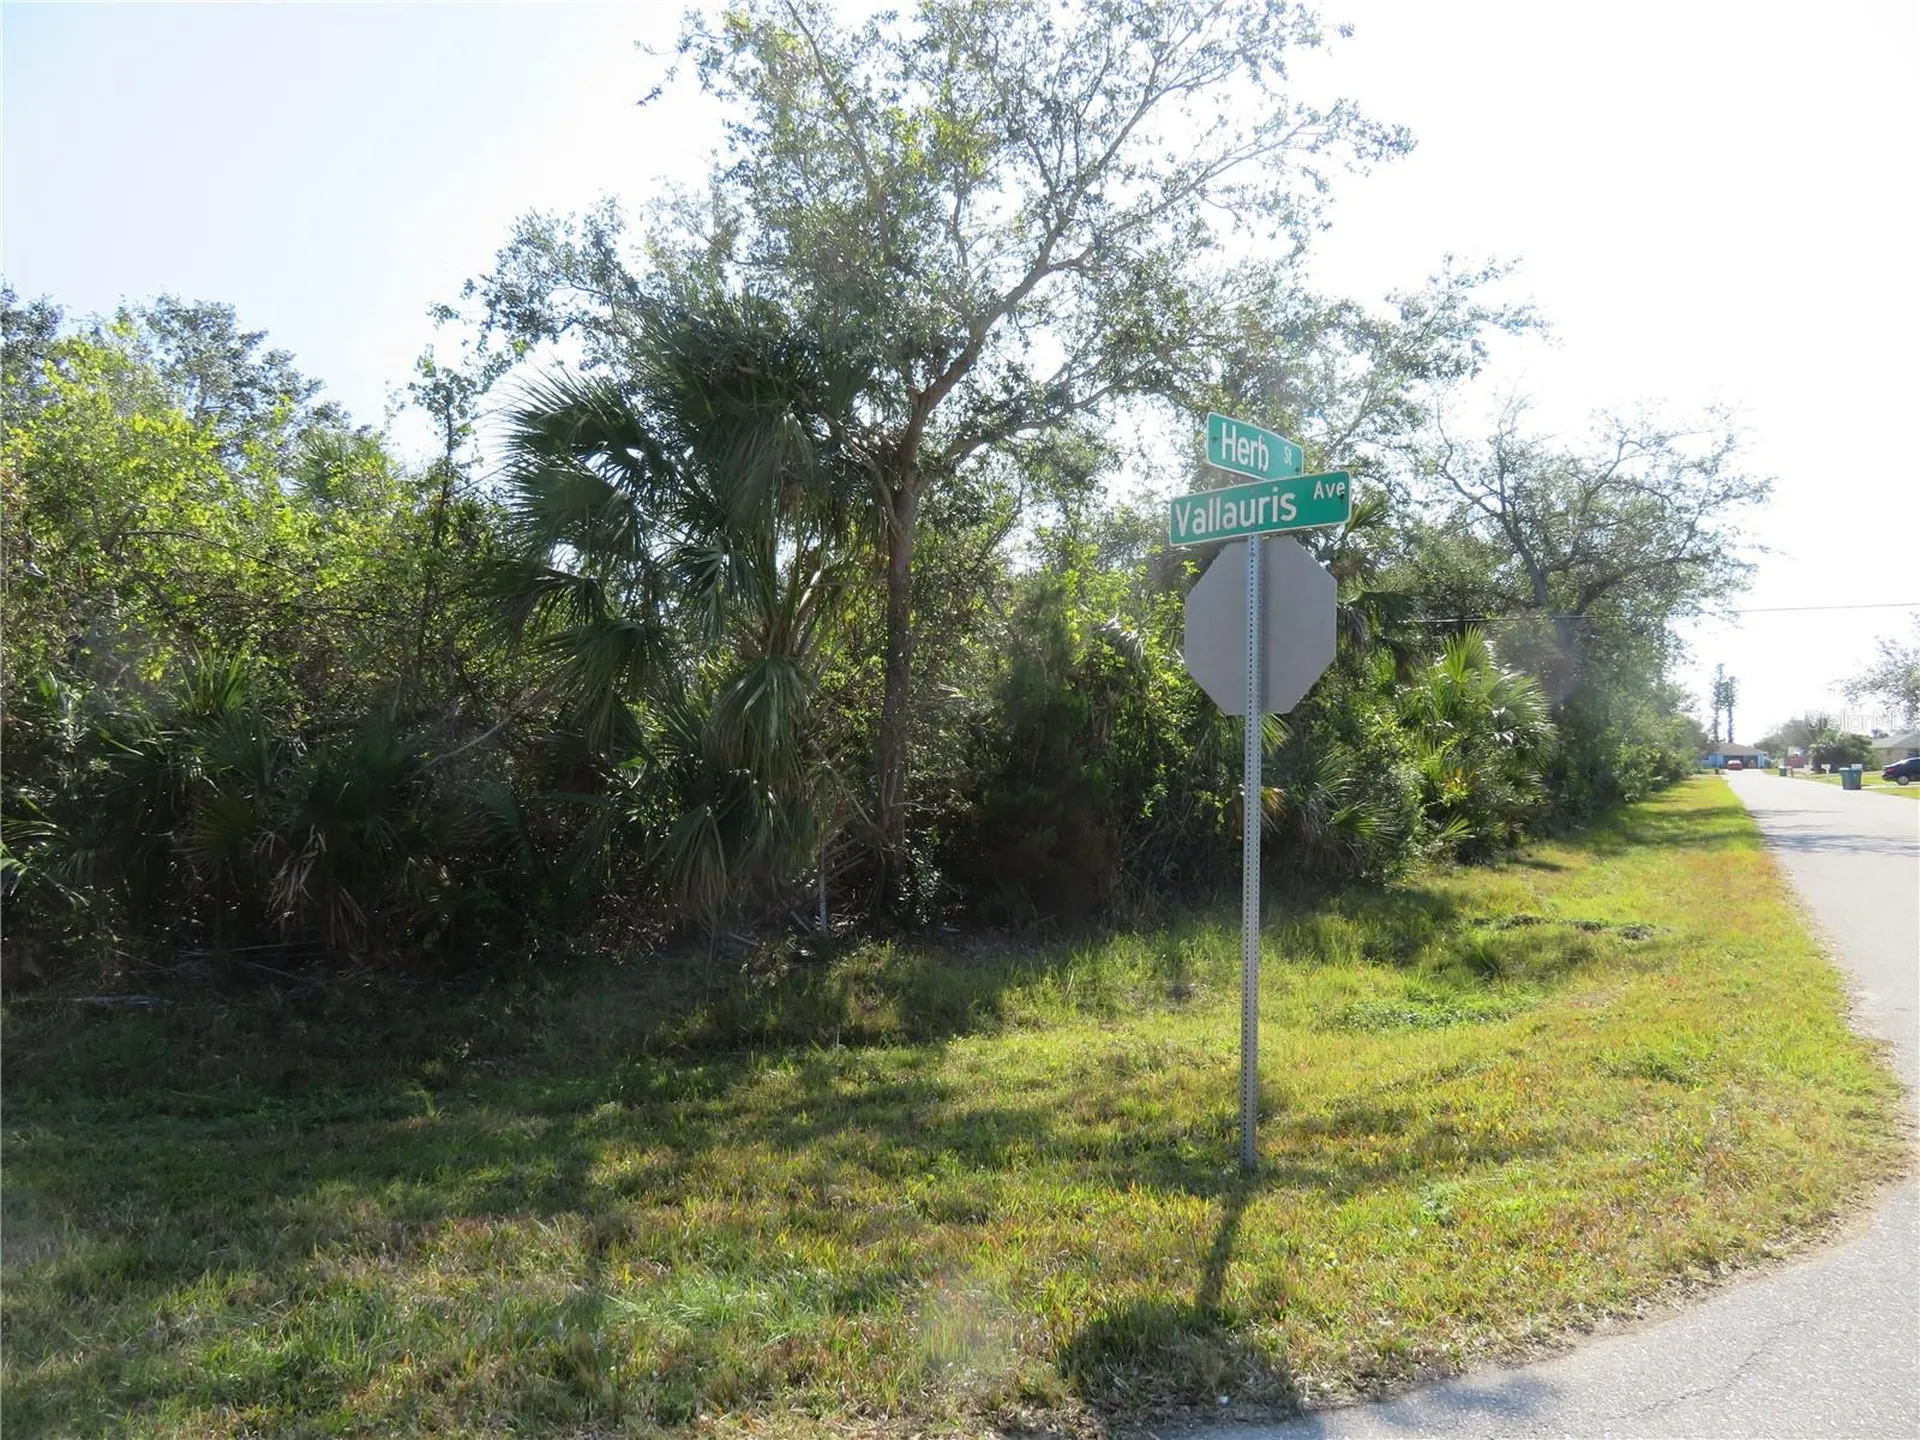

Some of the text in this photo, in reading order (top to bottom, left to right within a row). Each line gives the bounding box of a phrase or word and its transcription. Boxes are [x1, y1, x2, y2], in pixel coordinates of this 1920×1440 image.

[1221, 422, 1269, 472] Herb
[1175, 481, 1345, 537] Vallauris Ave
